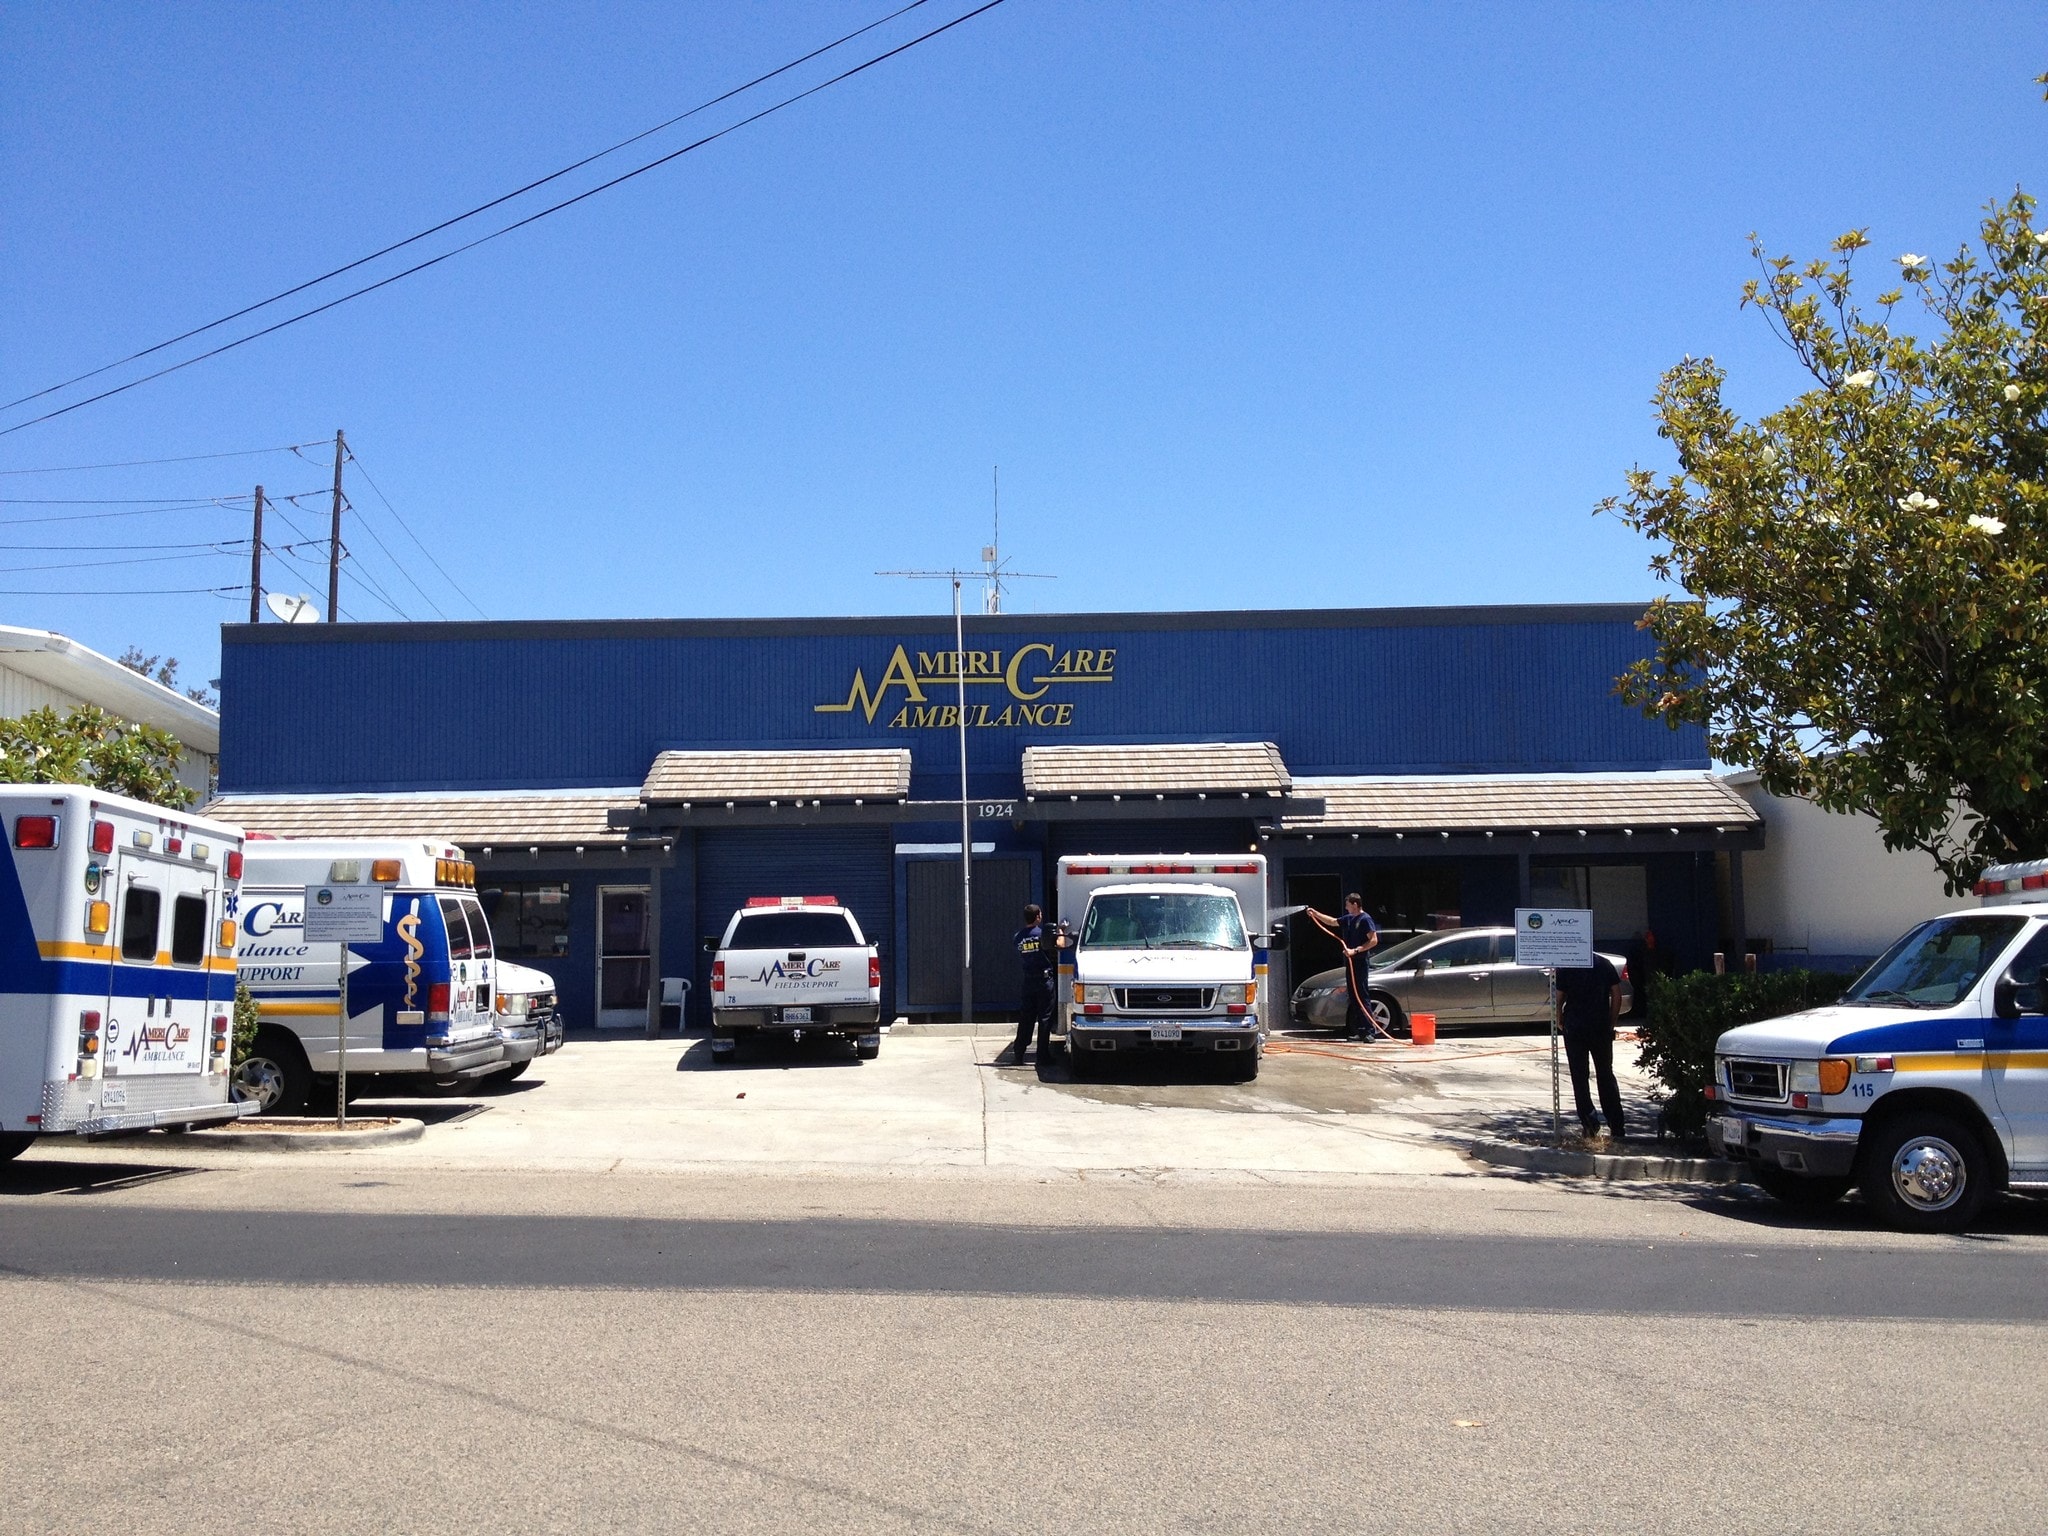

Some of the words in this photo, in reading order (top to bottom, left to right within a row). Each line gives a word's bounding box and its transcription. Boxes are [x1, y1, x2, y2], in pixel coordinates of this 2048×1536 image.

[888, 703, 1073, 728] AMBULANCE
[979, 804, 1014, 817] 1924
[243, 902, 304, 937] CAR
[238, 943, 309, 957] ulance
[1023, 942, 1040, 951] EMT
[237, 967, 304, 982] UPPORT
[106, 1049, 116, 1062] 117
[143, 1051, 185, 1061] AMBULANCE
[1851, 1083, 1874, 1098] 115
